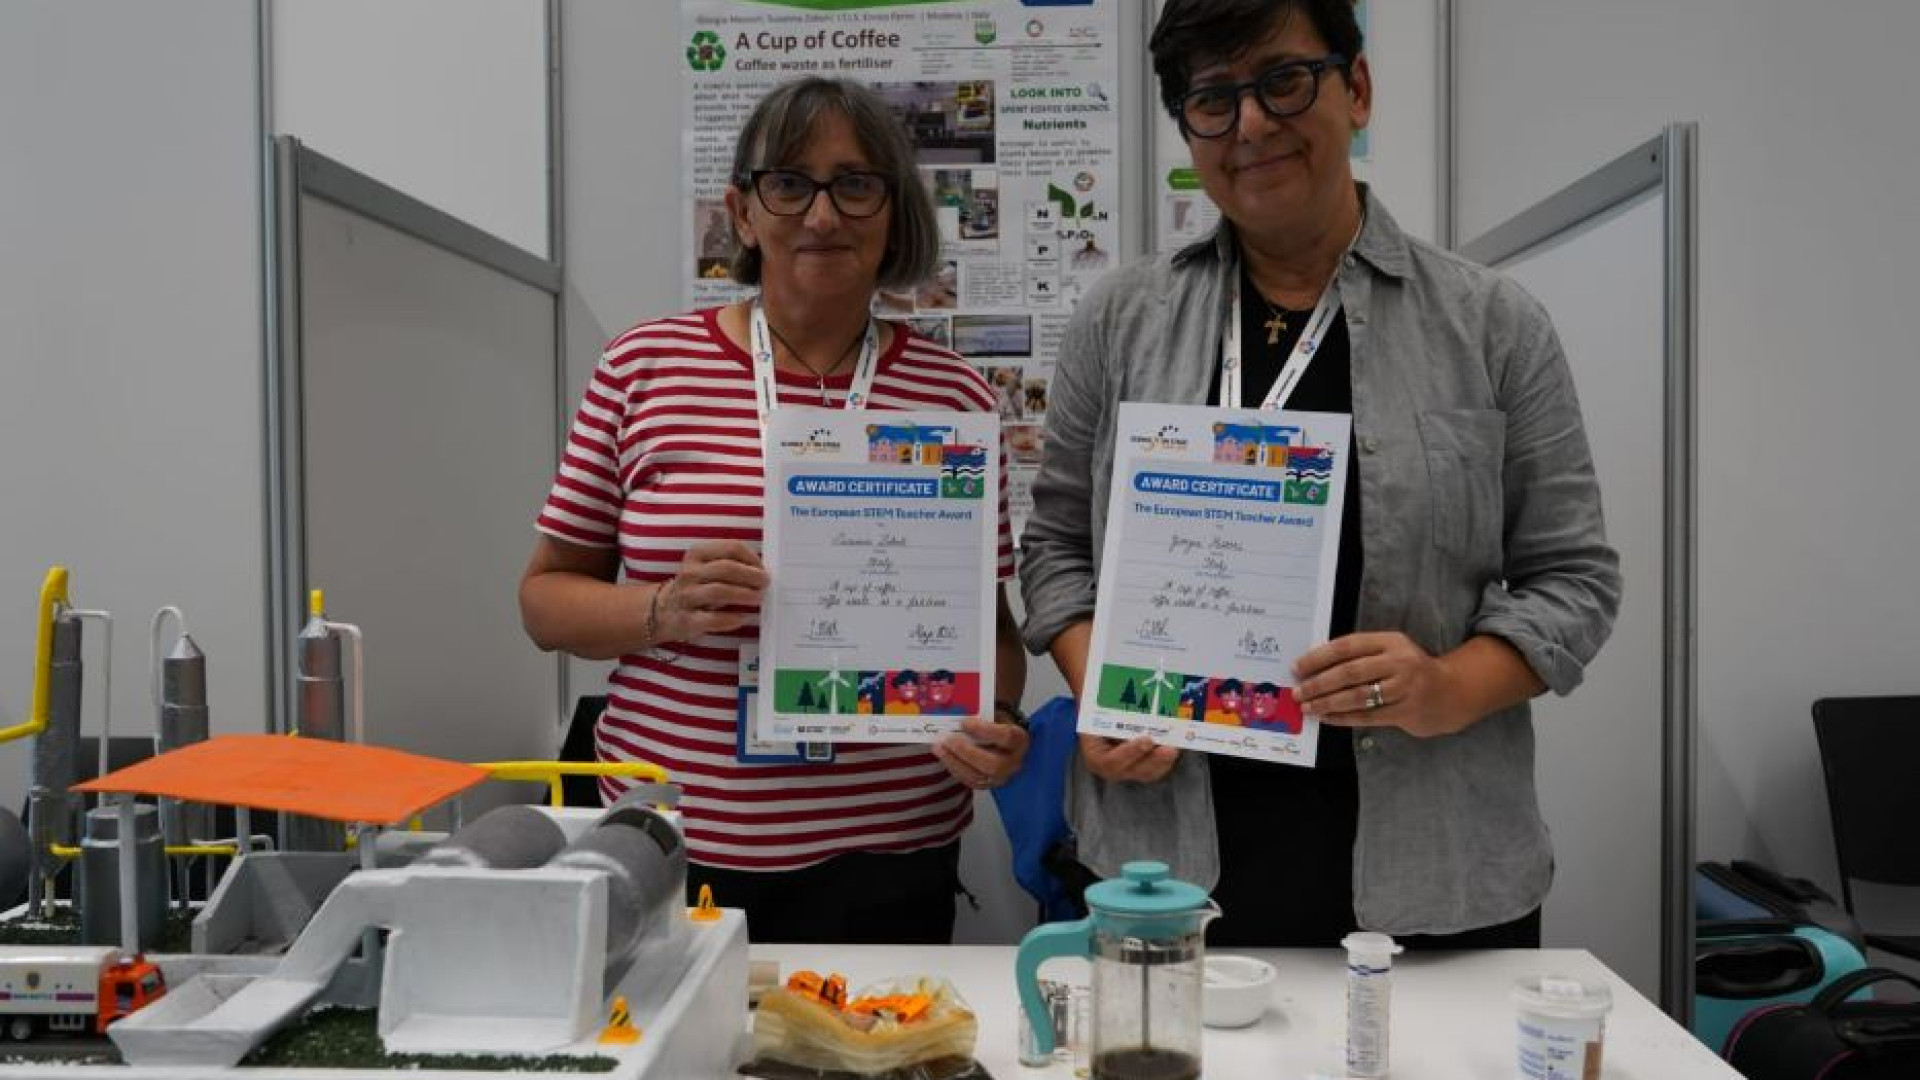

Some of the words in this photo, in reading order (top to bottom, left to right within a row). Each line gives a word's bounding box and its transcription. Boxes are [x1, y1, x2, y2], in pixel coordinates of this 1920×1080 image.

[735, 32, 751, 50] A
[757, 32, 797, 53] Cup
[804, 30, 826, 48] of
[832, 29, 900, 48] Coffee
[735, 58, 777, 71] Coffee
[781, 60, 818, 70] waste
[823, 60, 835, 70] as
[839, 57, 893, 69] fertiliser
[1010, 87, 1047, 98] LOOK
[1050, 87, 1082, 97] INTO
[1022, 119, 1087, 130] Nutrients
[1037, 209, 1048, 218] N
[1037, 246, 1048, 255] P
[1037, 281, 1049, 291] K
[794, 481, 845, 492] AWARD
[847, 482, 933, 495] CERTIFICATE
[1140, 477, 1188, 491] AWARD
[1190, 479, 1275, 499] CERTIFICATE
[790, 506, 810, 516] The
[811, 506, 861, 519] European
[863, 507, 893, 518] STEM
[896, 508, 935, 519] Teacher
[938, 509, 972, 520] Award
[1135, 503, 1152, 514] The
[1154, 504, 1202, 519] European
[1204, 507, 1233, 521] STEM
[1235, 510, 1277, 525] Teacher
[1278, 514, 1314, 527] Award
